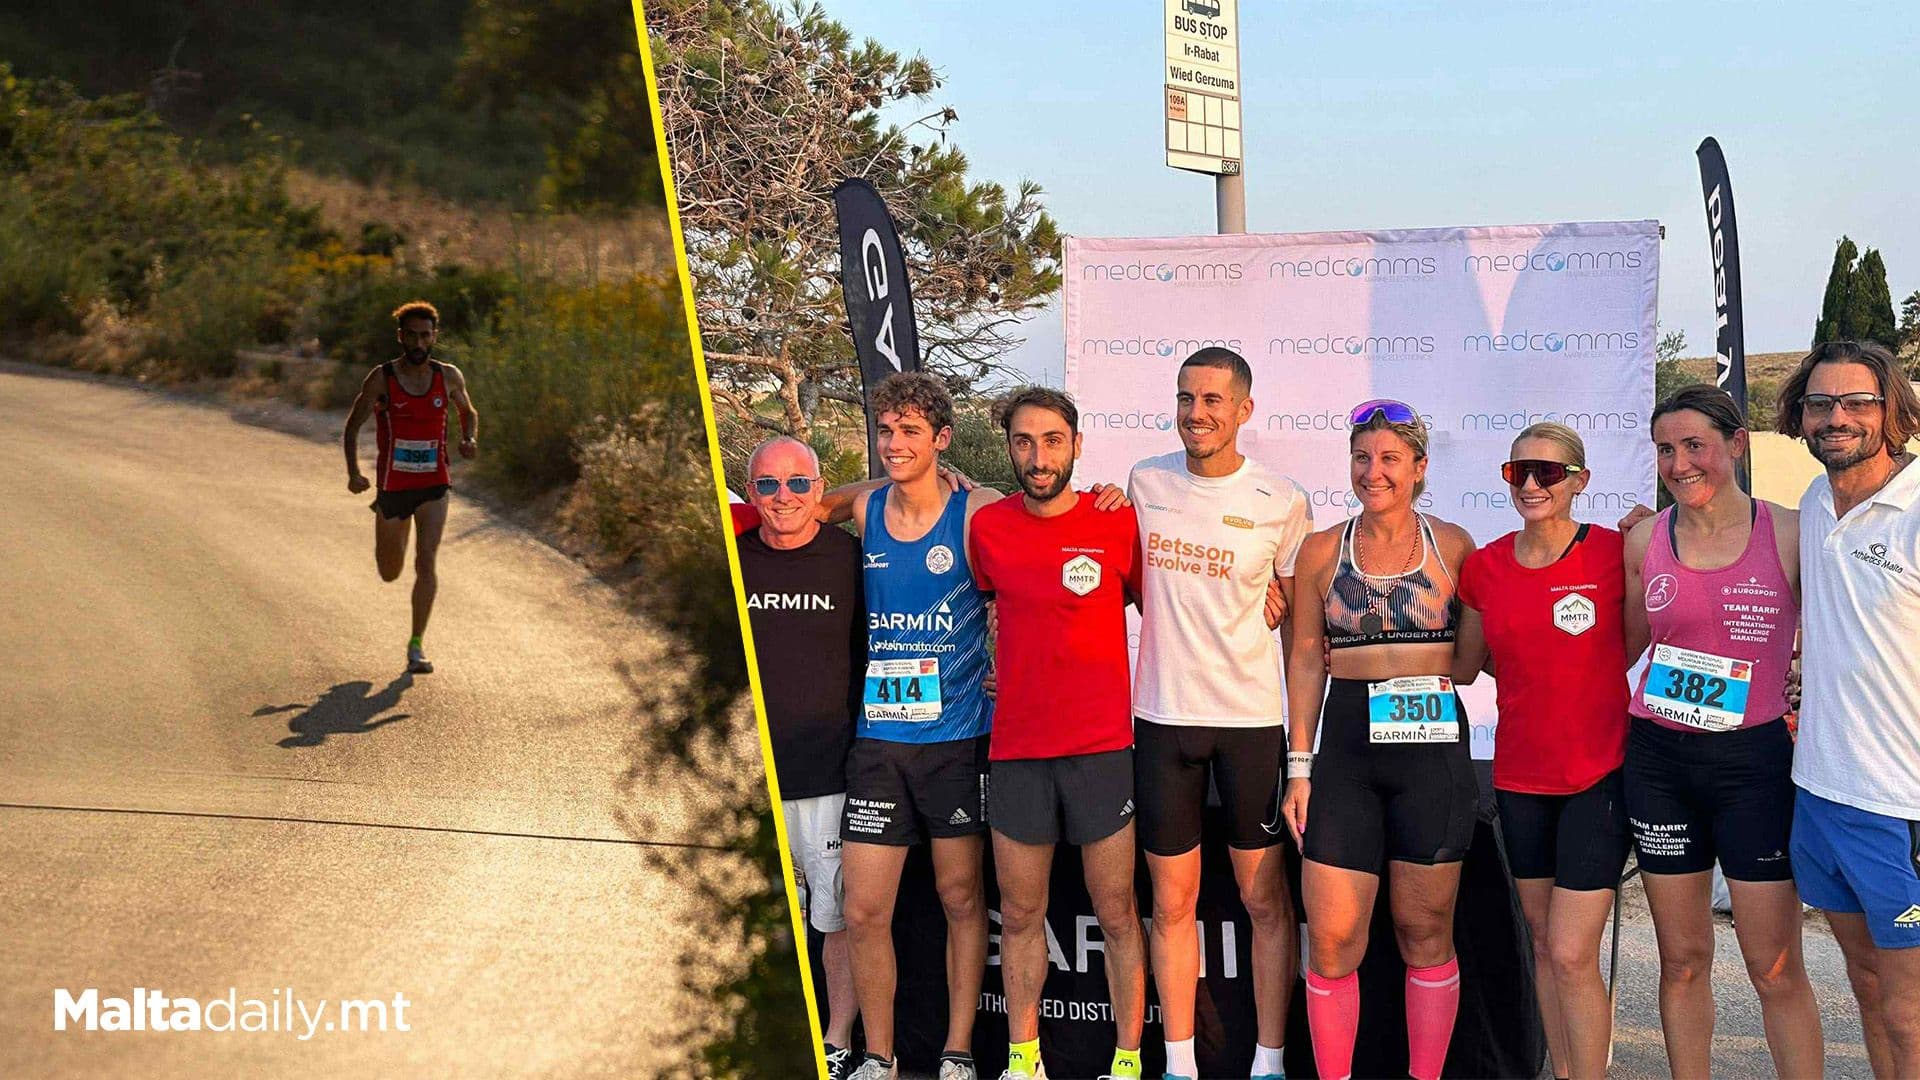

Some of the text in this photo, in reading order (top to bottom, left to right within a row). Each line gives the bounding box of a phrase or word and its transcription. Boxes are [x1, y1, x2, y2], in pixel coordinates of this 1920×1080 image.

[1174, 15, 1228, 40] BUS STOP
[1184, 43, 1220, 62] Ir-Rabat
[1170, 65, 1235, 90] Wied Gerzuma
[1169, 94, 1185, 105] 109A
[1223, 161, 1239, 173] 6387
[1270, 256, 1436, 278] medcomms
[1465, 250, 1642, 272] medcomms
[1083, 260, 1243, 282] medcomms
[1269, 334, 1435, 355] medcomms
[1463, 330, 1639, 352] medcomms
[1148, 532, 1235, 564] Betsson
[1147, 551, 1233, 580] Evolve 5K
[1850, 549, 1903, 574] Athletics Malta
[1068, 575, 1095, 583] MMTR
[1560, 613, 1589, 622] MMTR
[1723, 604, 1780, 615] TEAM BARRY
[869, 612, 953, 632] GARMIN
[1723, 620, 1777, 630] INTERNATIONAL
[1387, 631, 1429, 639] UNDER
[1730, 627, 1770, 636] CHALLENGE
[1730, 634, 1768, 643] MARATHON
[877, 677, 923, 702] 414
[1665, 668, 1728, 709] 382
[867, 710, 909, 720] GARMIN
[1389, 693, 1442, 721] 350
[1646, 703, 1702, 726] GARMIN
[1372, 731, 1427, 740] GARMIN
[849, 798, 897, 810] TEAM BARRY
[1629, 817, 1650, 830] TEAM
[1643, 830, 1671, 838] MALTA
[1640, 841, 1685, 850] CHALLENGE
[1641, 847, 1685, 856] MARATHON
